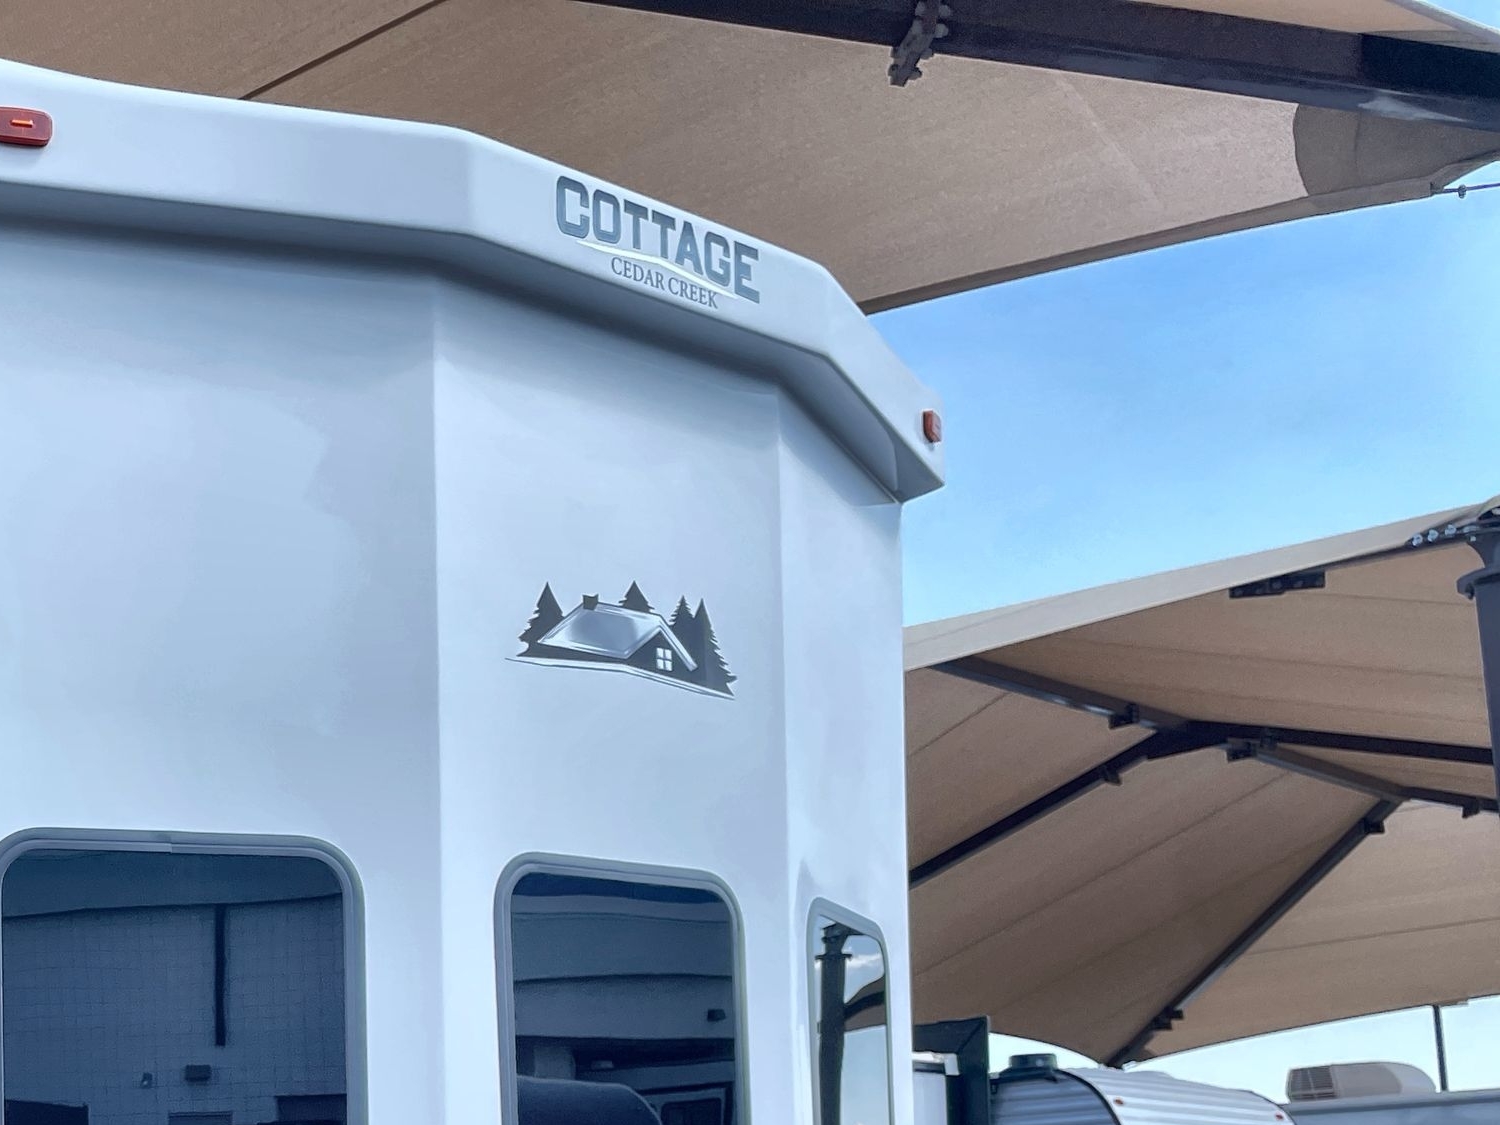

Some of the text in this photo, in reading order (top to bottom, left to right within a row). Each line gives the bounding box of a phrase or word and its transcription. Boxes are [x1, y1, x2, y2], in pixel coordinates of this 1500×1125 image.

[556, 175, 760, 304] COTTAGE
[610, 256, 718, 309] CEDAR CREEK
